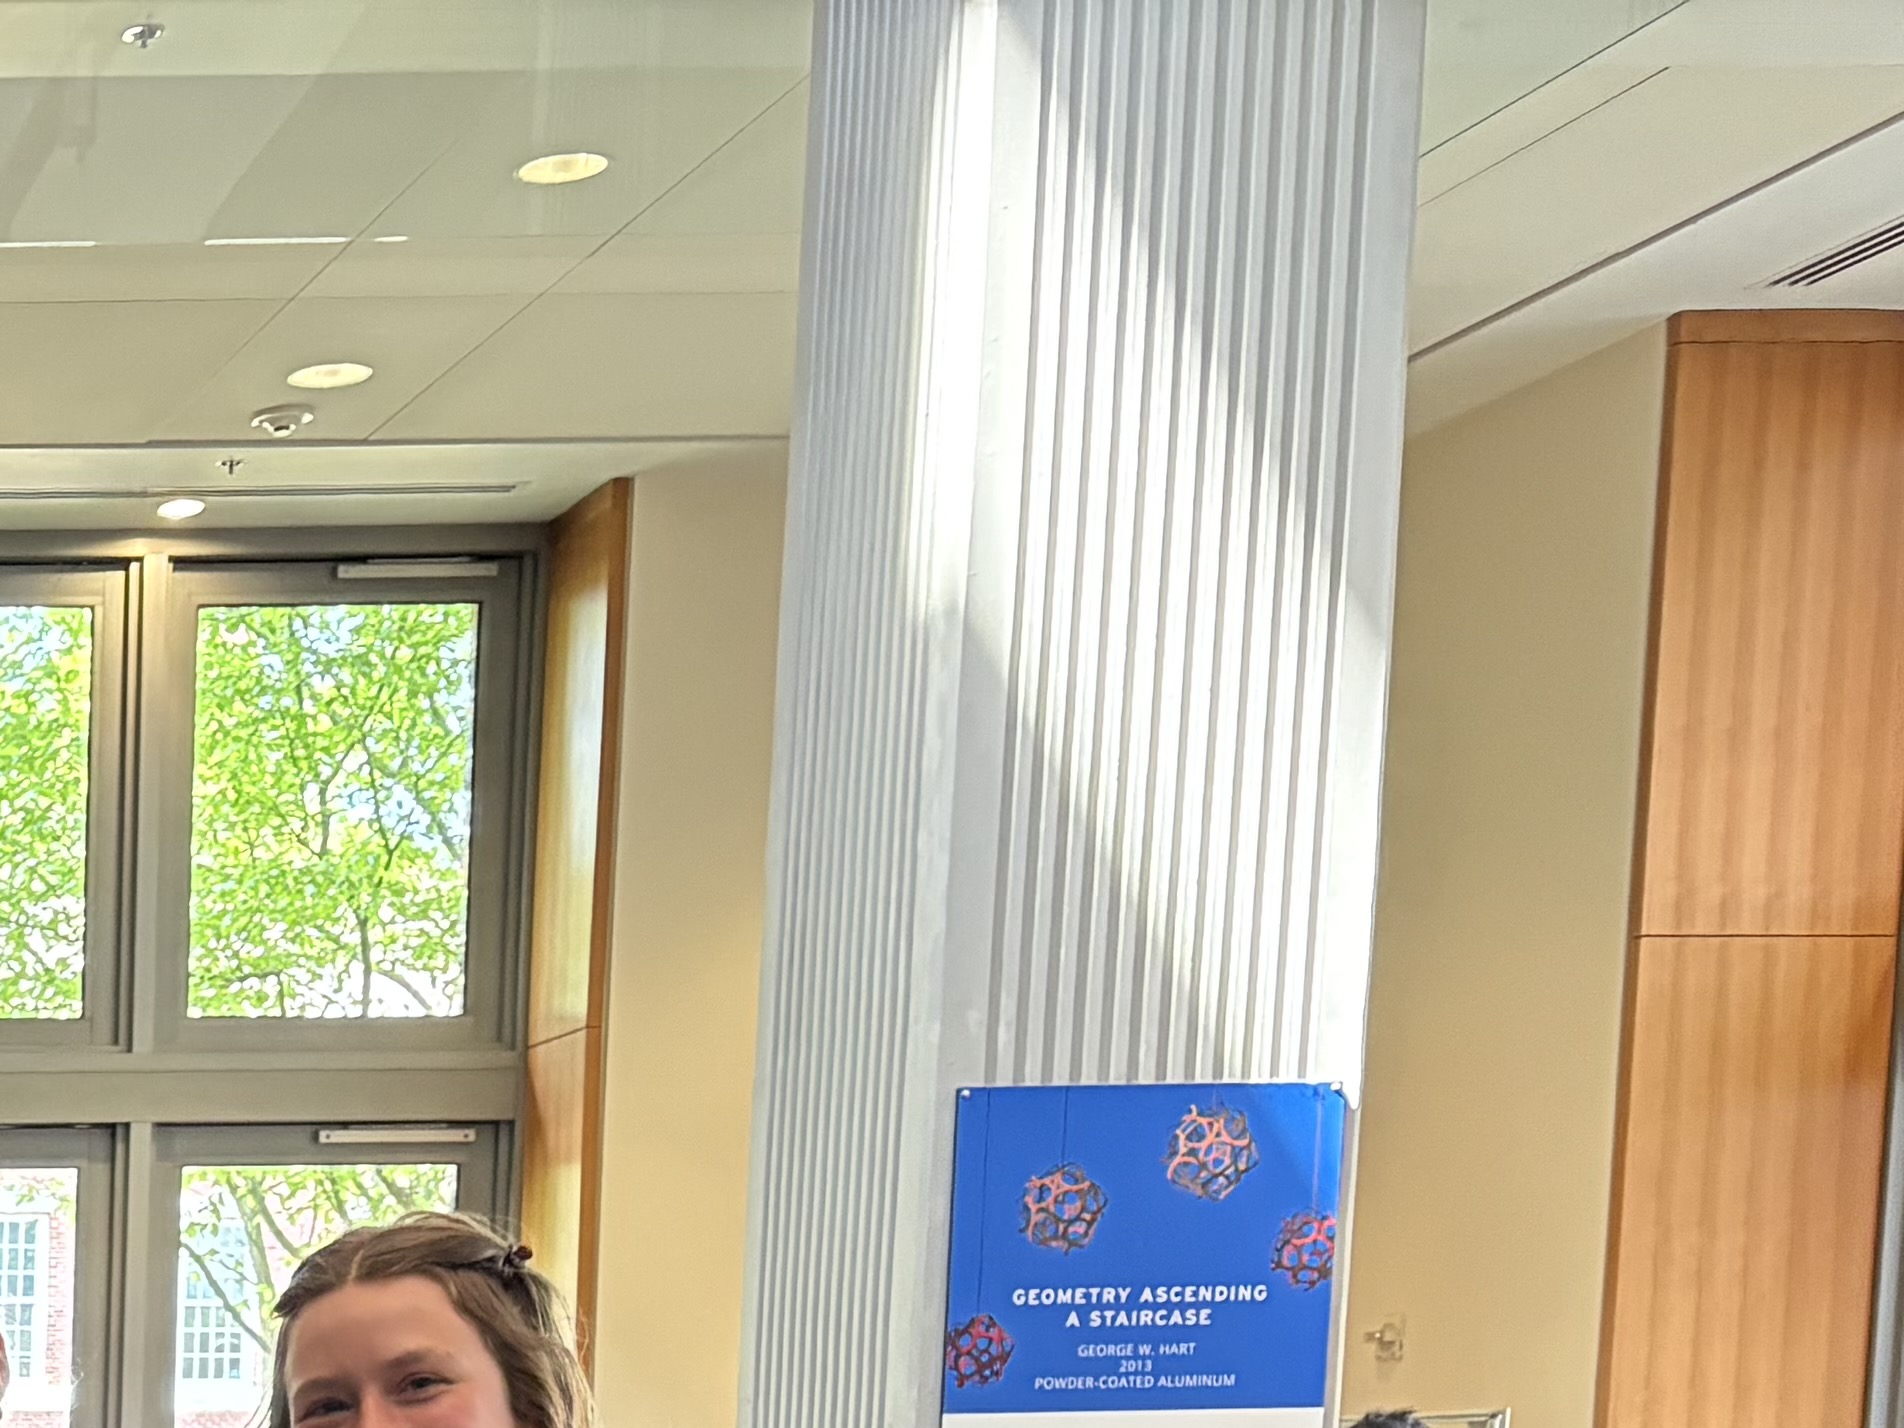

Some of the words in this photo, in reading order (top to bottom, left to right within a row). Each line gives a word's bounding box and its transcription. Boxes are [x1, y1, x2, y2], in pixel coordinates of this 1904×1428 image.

[1012, 1286, 1132, 1306] GEOMETRY
[1139, 1284, 1268, 1304] ASCENDING
[1065, 1310, 1081, 1328] A
[1089, 1308, 1212, 1327] STAIRCASE
[1077, 1344, 1134, 1357] GEORGE
[1138, 1343, 1154, 1356] W.
[1159, 1342, 1196, 1355] HART
[1119, 1359, 1152, 1373] 2013
[1034, 1375, 1154, 1390] POWDER-COATED
[1157, 1373, 1235, 1387] ALUMINUM
